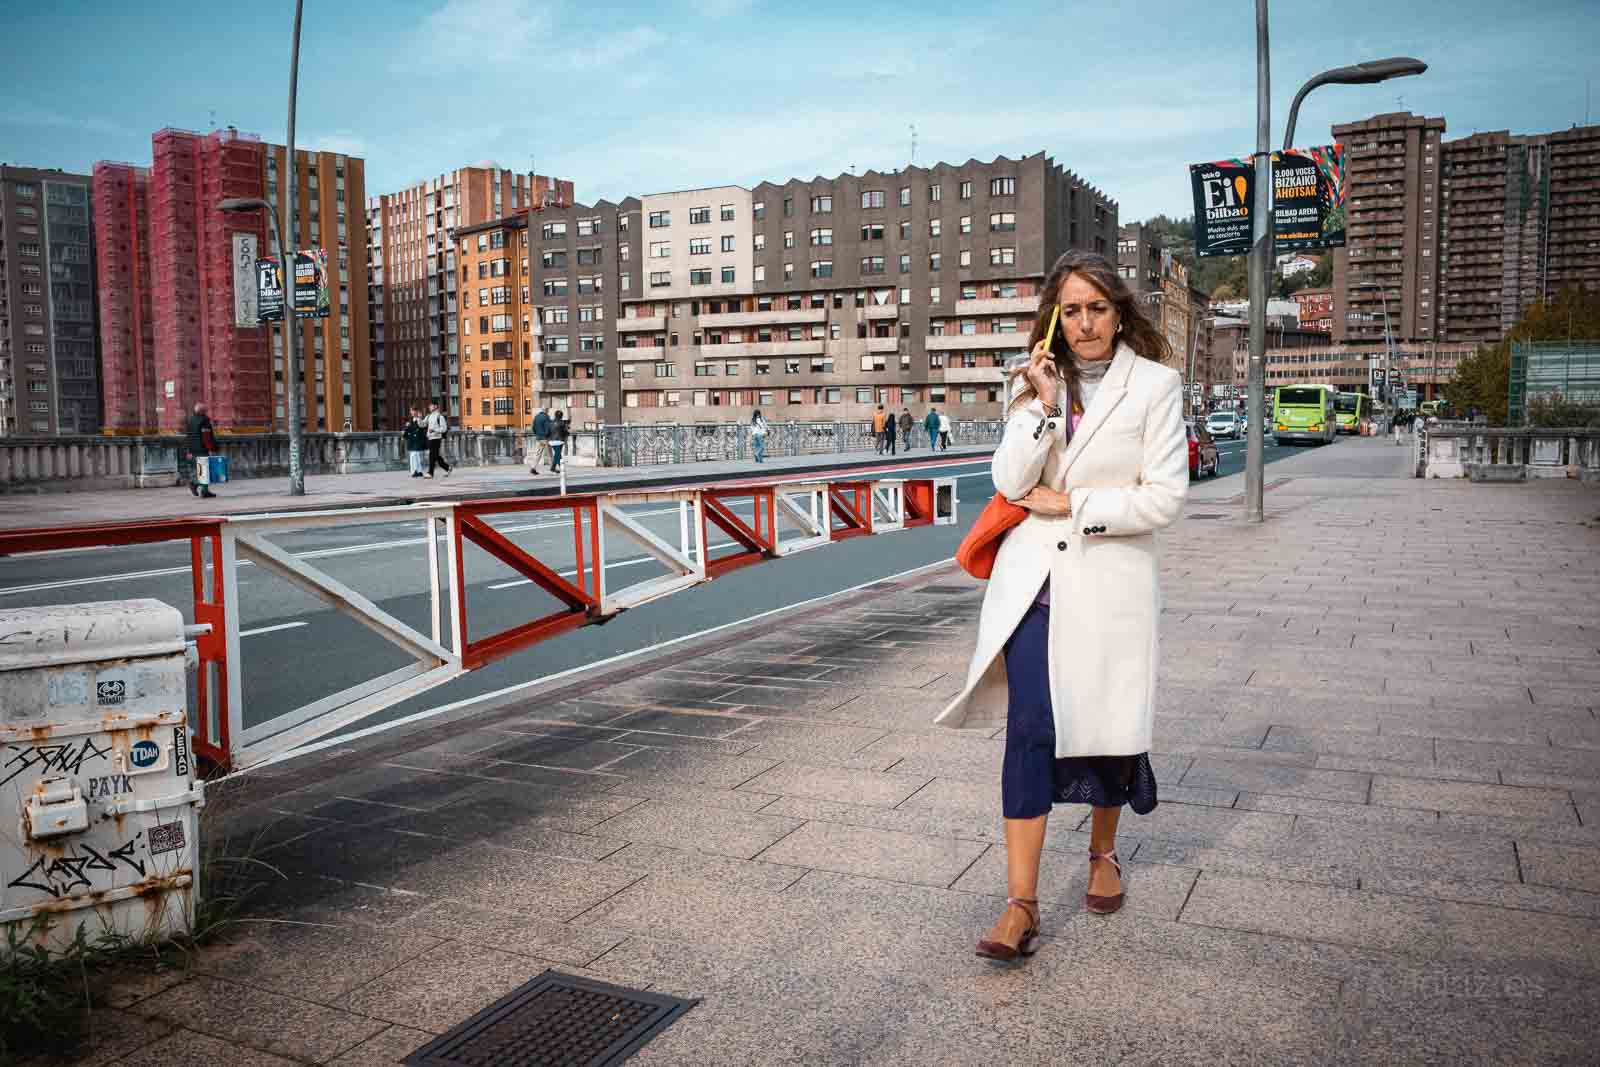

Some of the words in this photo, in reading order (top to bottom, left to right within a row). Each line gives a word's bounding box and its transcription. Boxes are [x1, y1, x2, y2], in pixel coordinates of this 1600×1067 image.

[1275, 169, 1294, 178] 3.000
[1295, 167, 1316, 176] VOCES
[1275, 175, 1317, 189] BIZKAIKO
[1275, 186, 1317, 199] AHOTSAK
[1206, 207, 1248, 219] bilbao
[1275, 209, 1298, 217] BILBAO
[1298, 208, 1318, 216] ARENA
